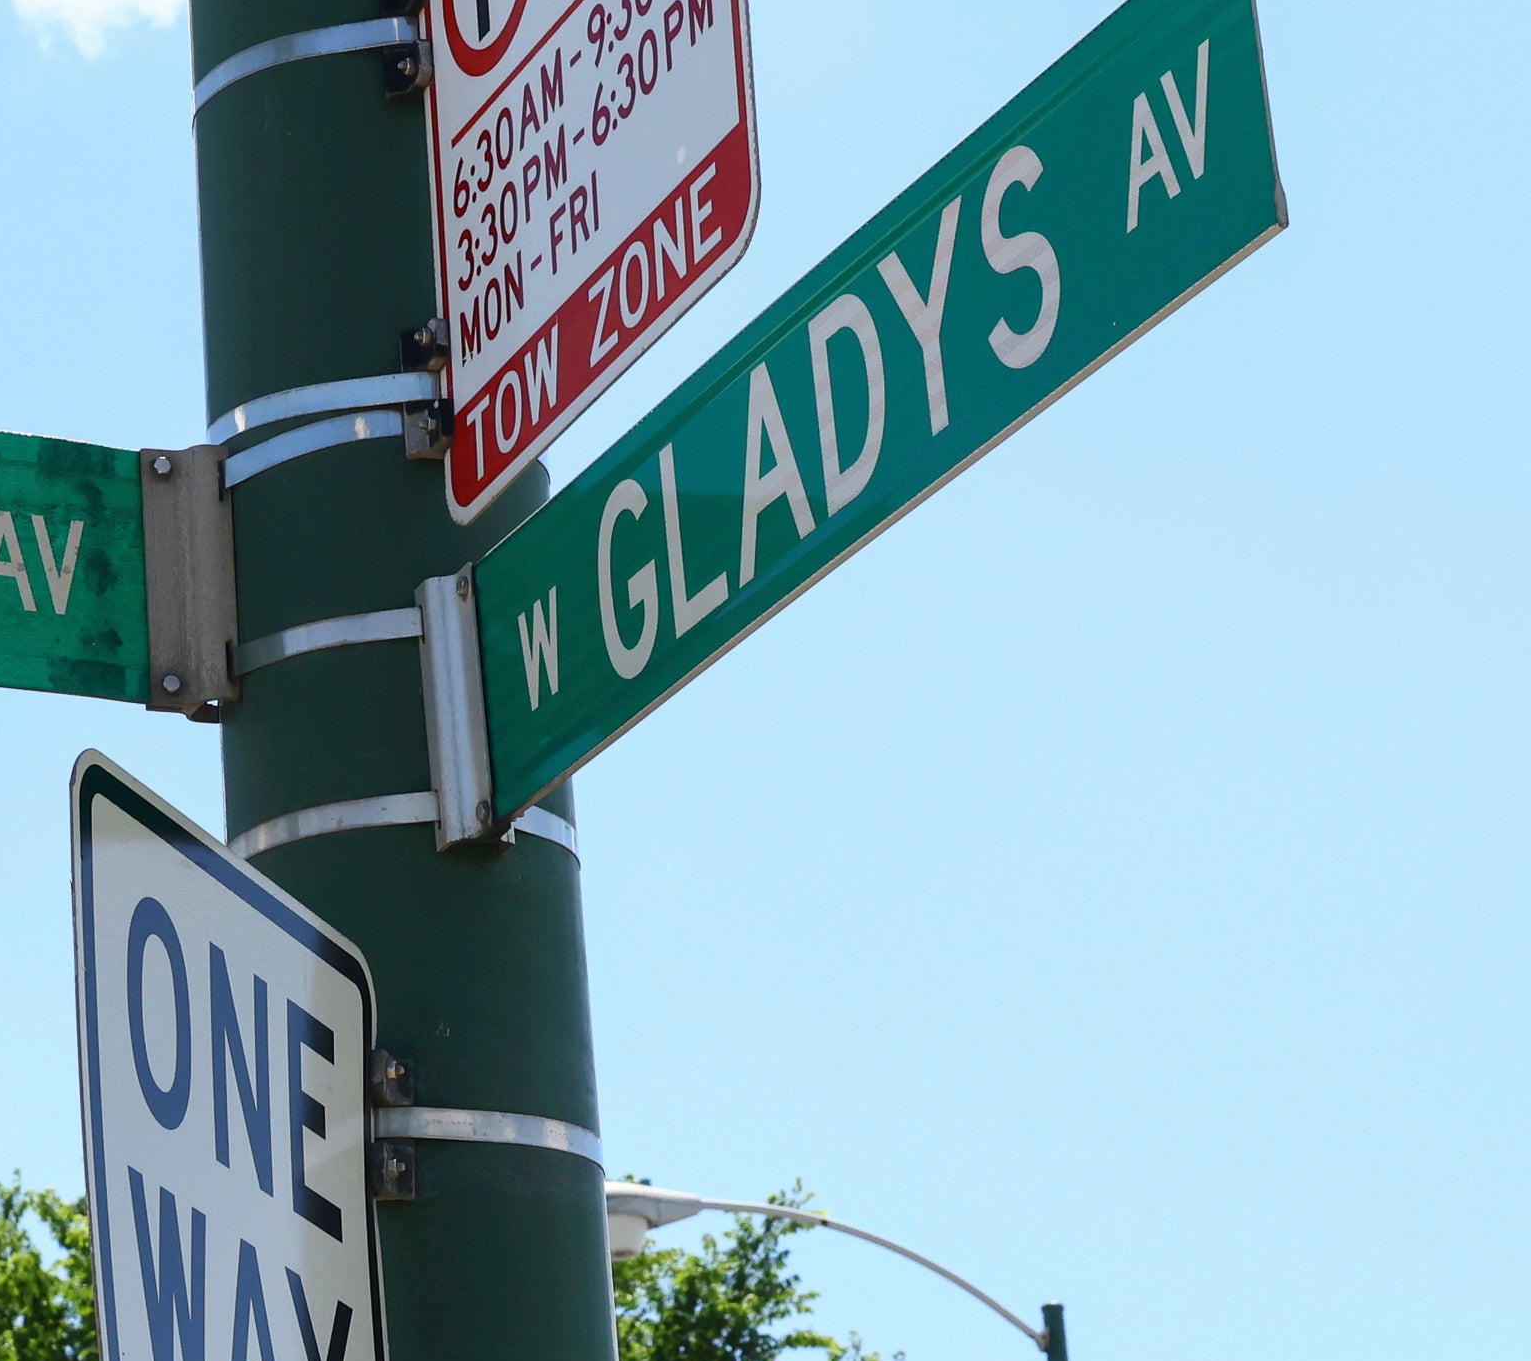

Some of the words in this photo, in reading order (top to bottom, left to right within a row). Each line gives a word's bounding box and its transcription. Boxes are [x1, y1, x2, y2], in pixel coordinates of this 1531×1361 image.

[466, 322, 560, 482] TOW
[587, 161, 723, 369] ZONE
[517, 585, 559, 711] W
[597, 145, 1061, 680] GLADYS
[1126, 39, 1210, 234] AV
[127, 896, 343, 1244] ONE
